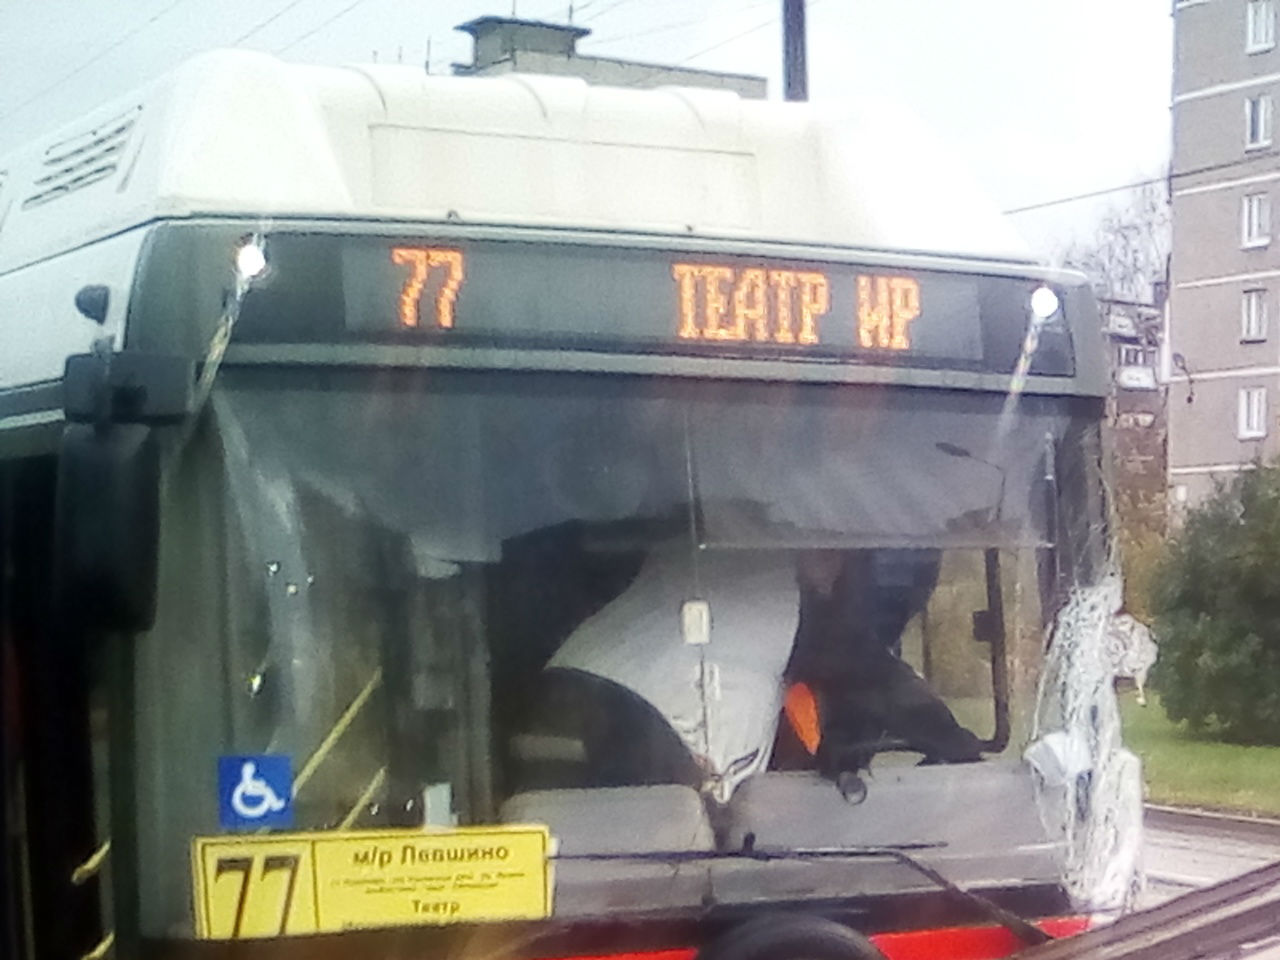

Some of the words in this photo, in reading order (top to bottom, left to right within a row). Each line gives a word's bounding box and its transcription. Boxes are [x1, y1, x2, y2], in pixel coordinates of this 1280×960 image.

[392, 246, 464, 330] 77
[671, 262, 830, 346] ТЕАТР
[214, 856, 299, 938] 77
[352, 846, 393, 869] м/р
